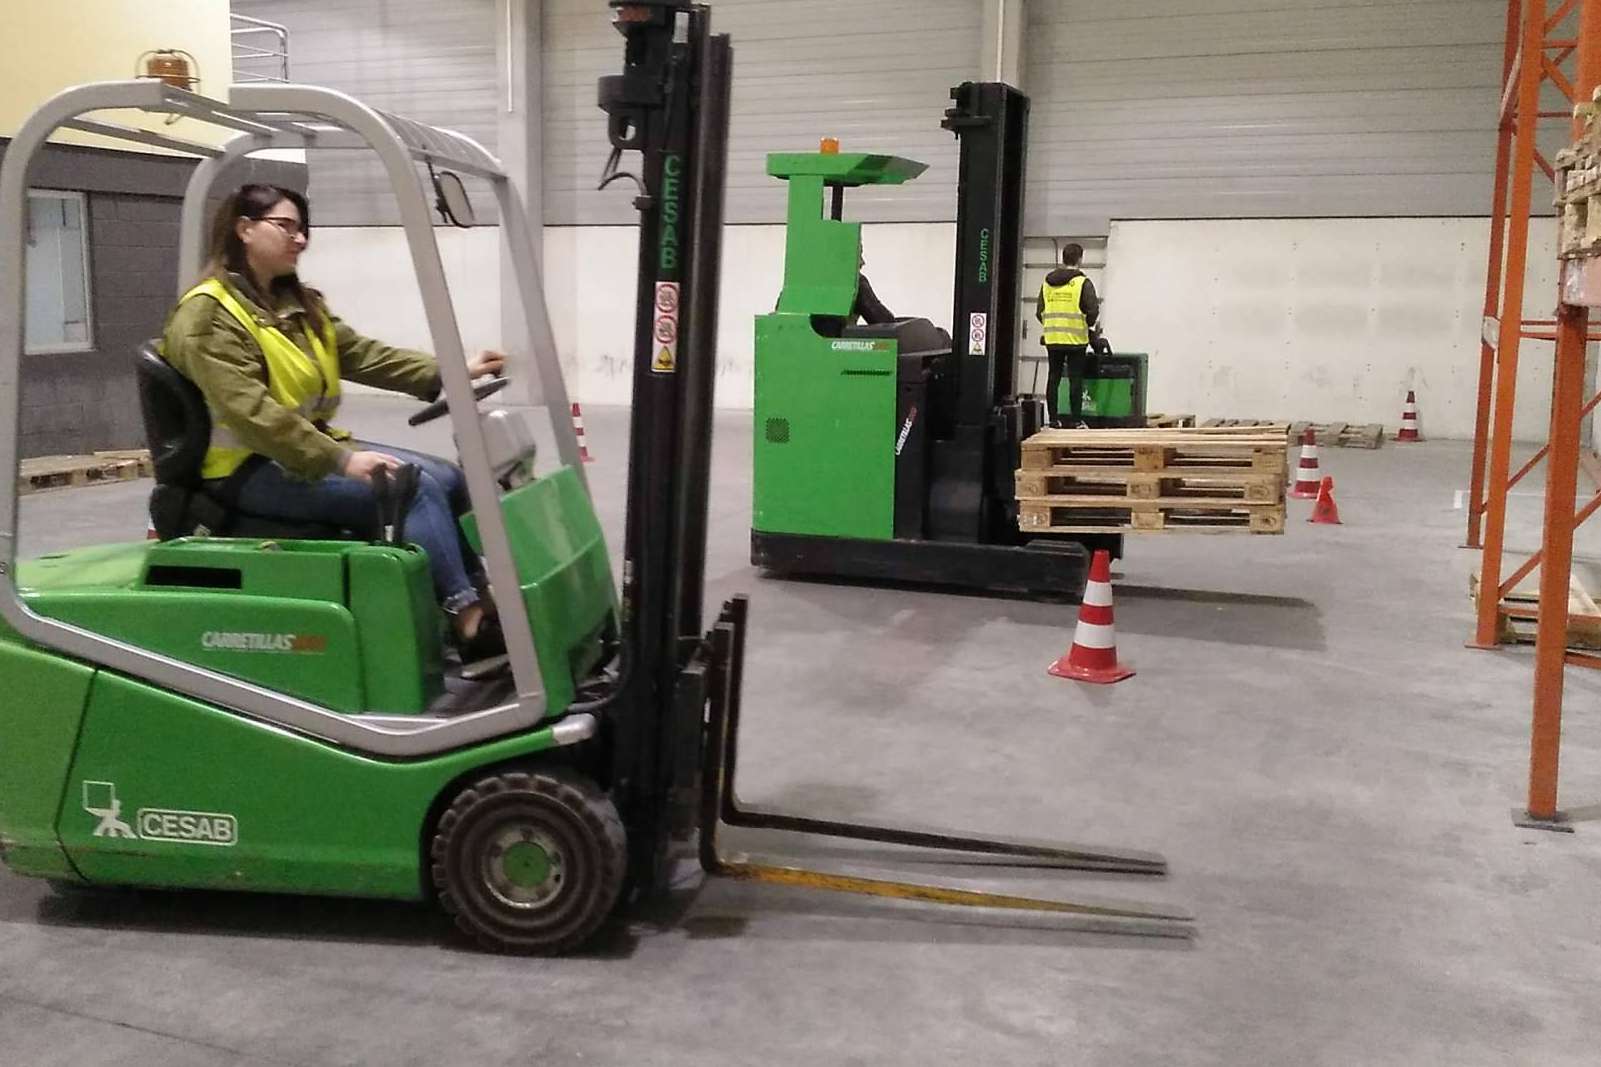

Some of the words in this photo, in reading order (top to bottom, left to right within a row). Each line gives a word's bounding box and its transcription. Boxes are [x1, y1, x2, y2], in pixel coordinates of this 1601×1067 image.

[661, 155, 681, 268] CESAB
[979, 228, 989, 283] CESAB
[143, 813, 231, 841] CESAB
